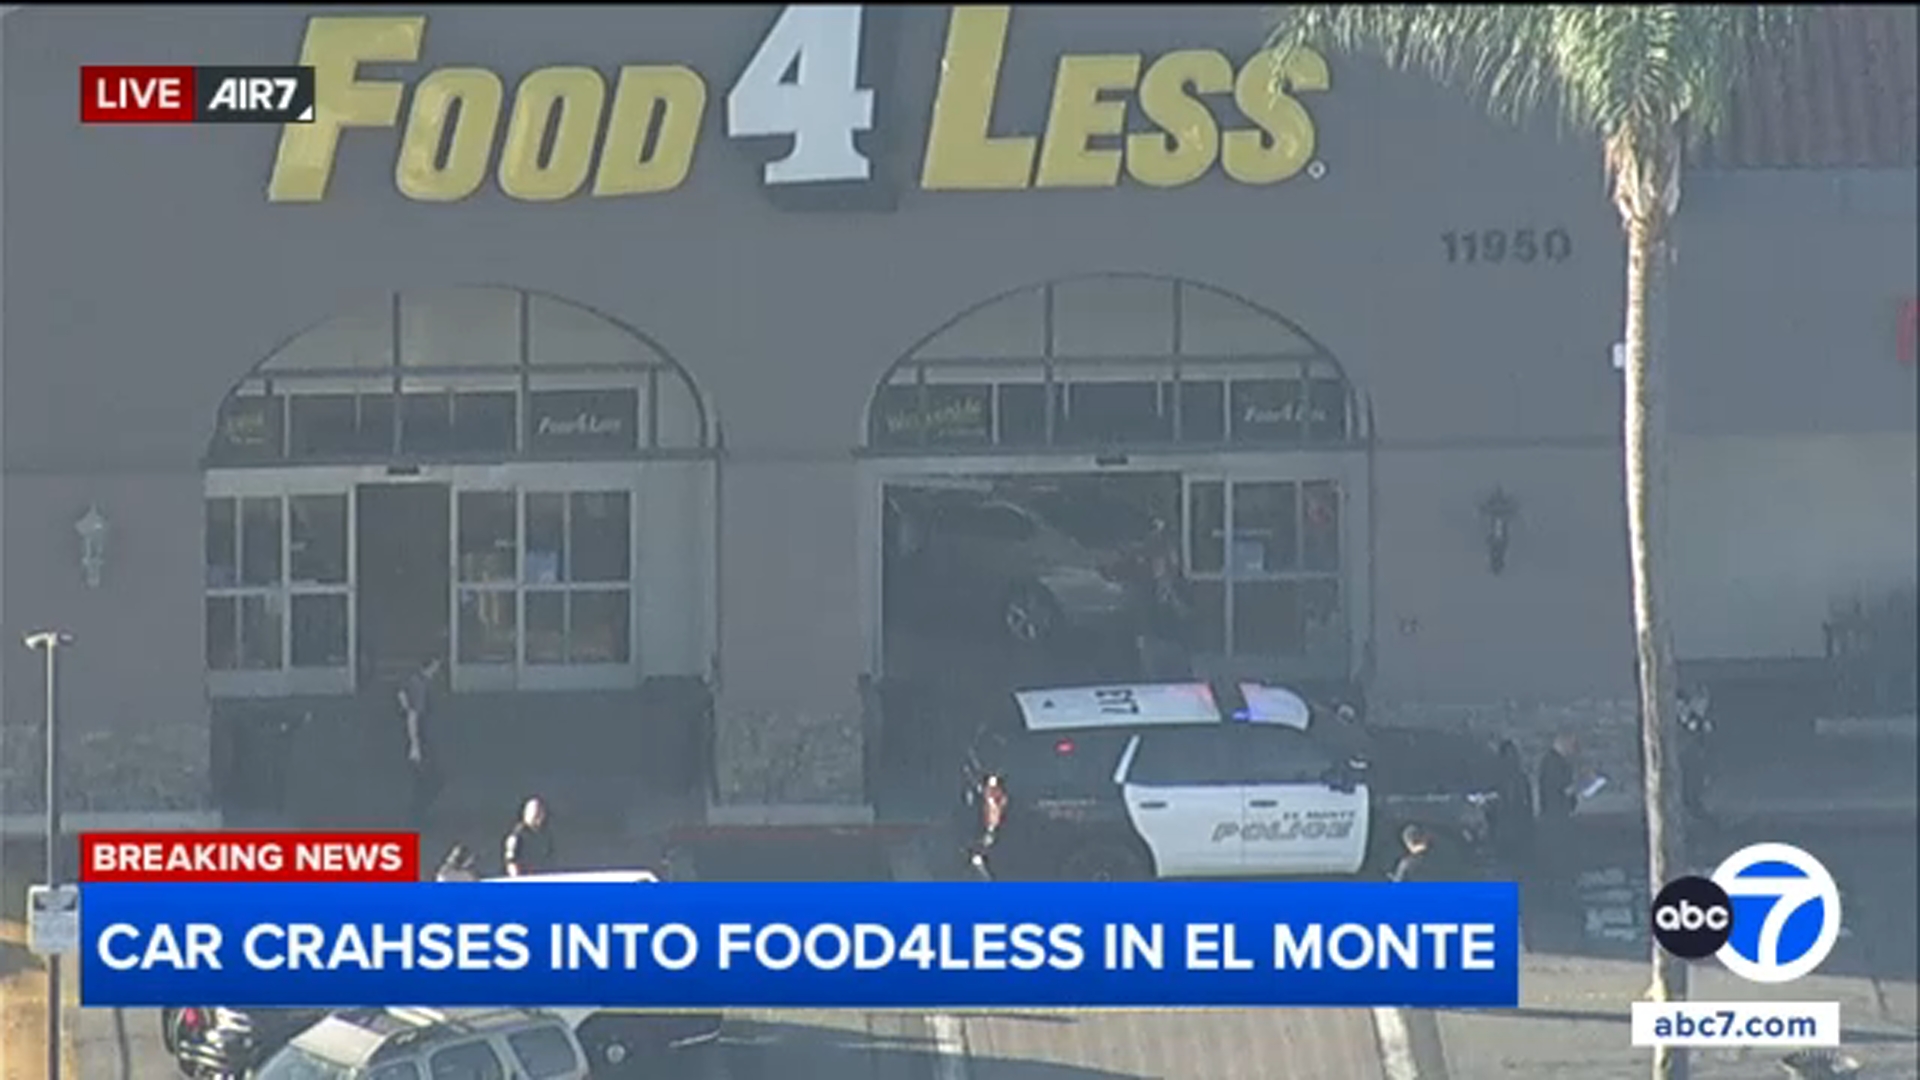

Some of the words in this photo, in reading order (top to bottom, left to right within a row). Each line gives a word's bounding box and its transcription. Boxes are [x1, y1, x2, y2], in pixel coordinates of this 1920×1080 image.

[267, 15, 706, 203] FOOD
[727, 5, 875, 184] 4
[921, 5, 1330, 190] LESS
[1440, 229, 1573, 264] 11950
[1211, 820, 1355, 843] POLICE
